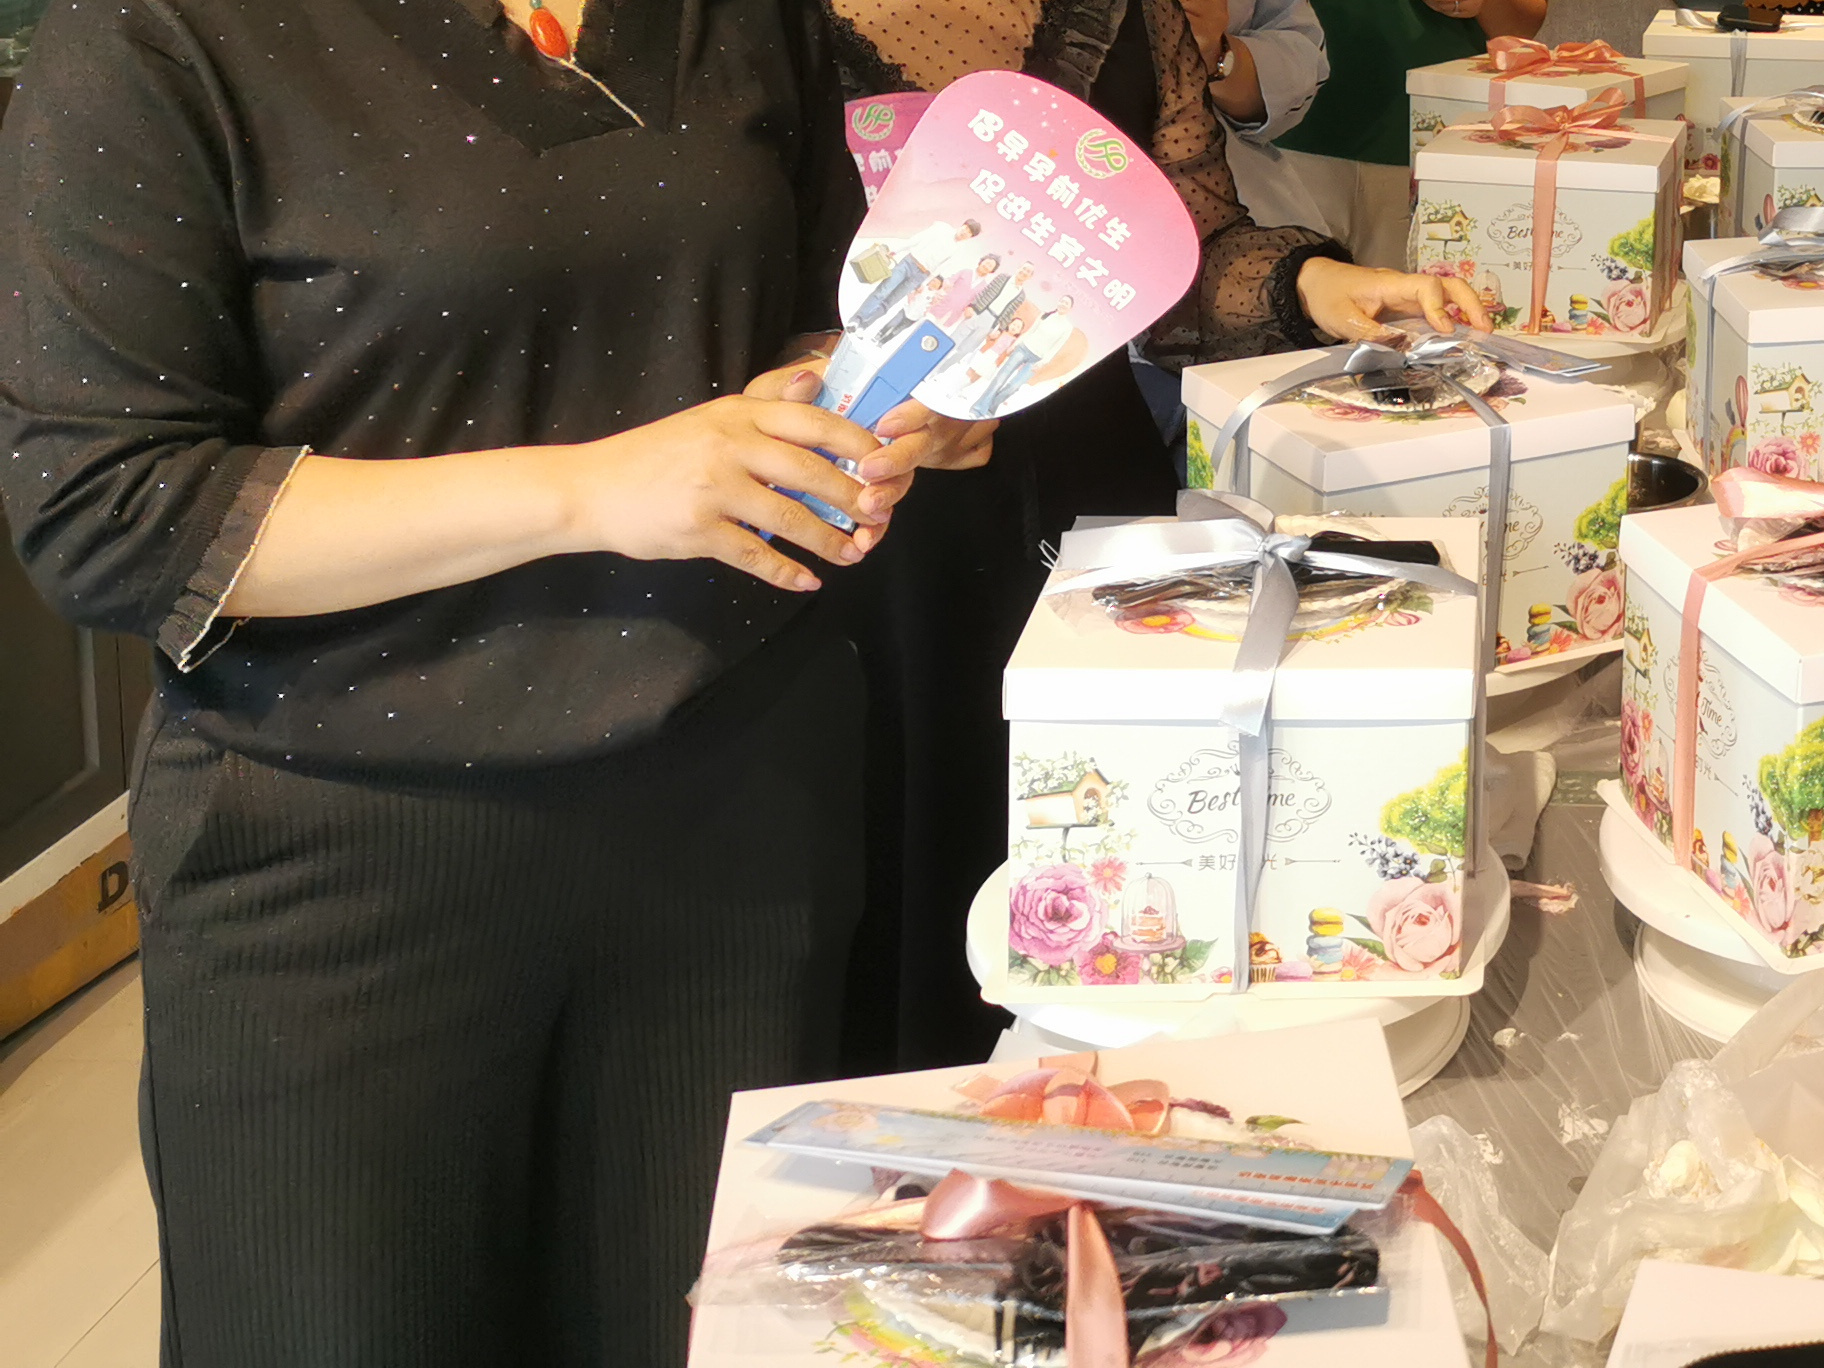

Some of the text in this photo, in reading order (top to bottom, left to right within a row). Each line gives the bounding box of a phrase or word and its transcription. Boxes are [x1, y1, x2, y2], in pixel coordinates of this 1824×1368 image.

[968, 109, 1132, 251] 倡导孕前优生
[970, 169, 1136, 311] 促进生育文明
[1187, 785, 1240, 814] Best
